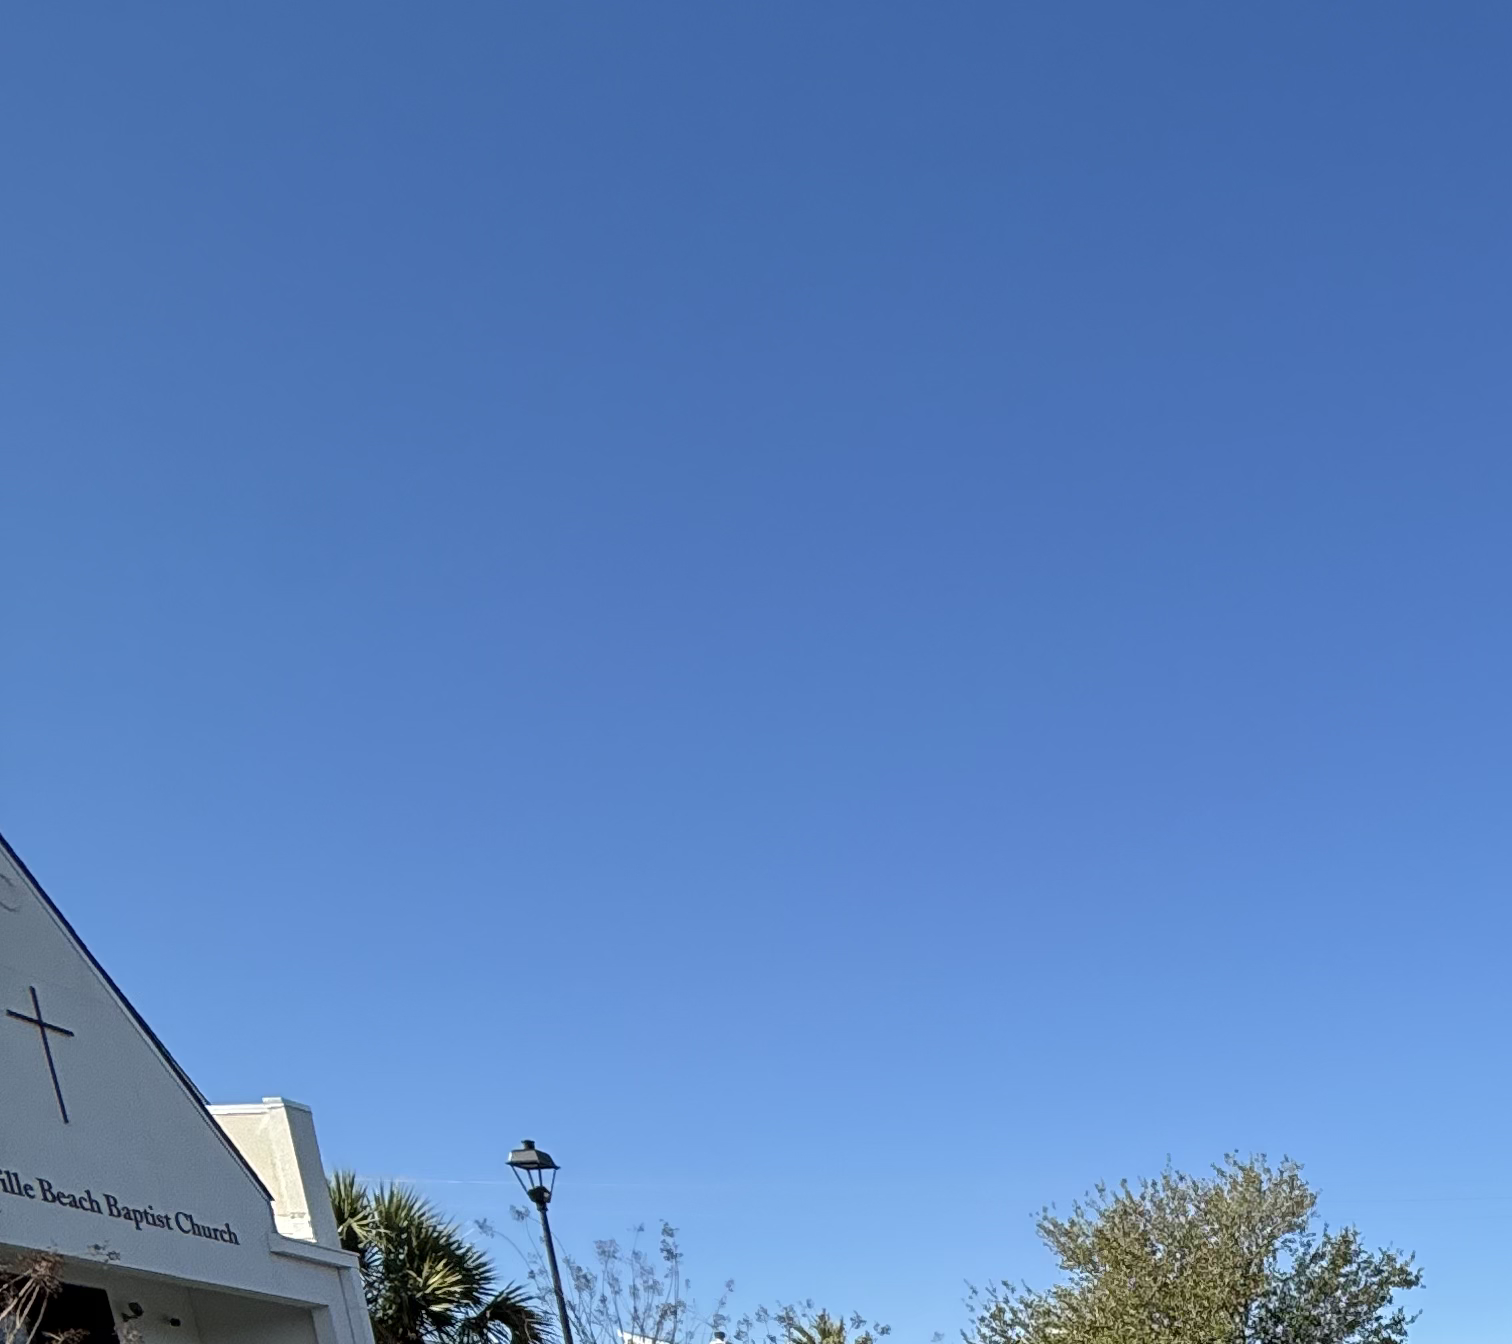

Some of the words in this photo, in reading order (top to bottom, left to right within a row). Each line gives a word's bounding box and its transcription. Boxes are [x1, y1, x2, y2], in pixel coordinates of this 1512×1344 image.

[35, 1177, 103, 1214] Beach
[103, 1193, 174, 1231] Baptist
[174, 1211, 240, 1245] Church
